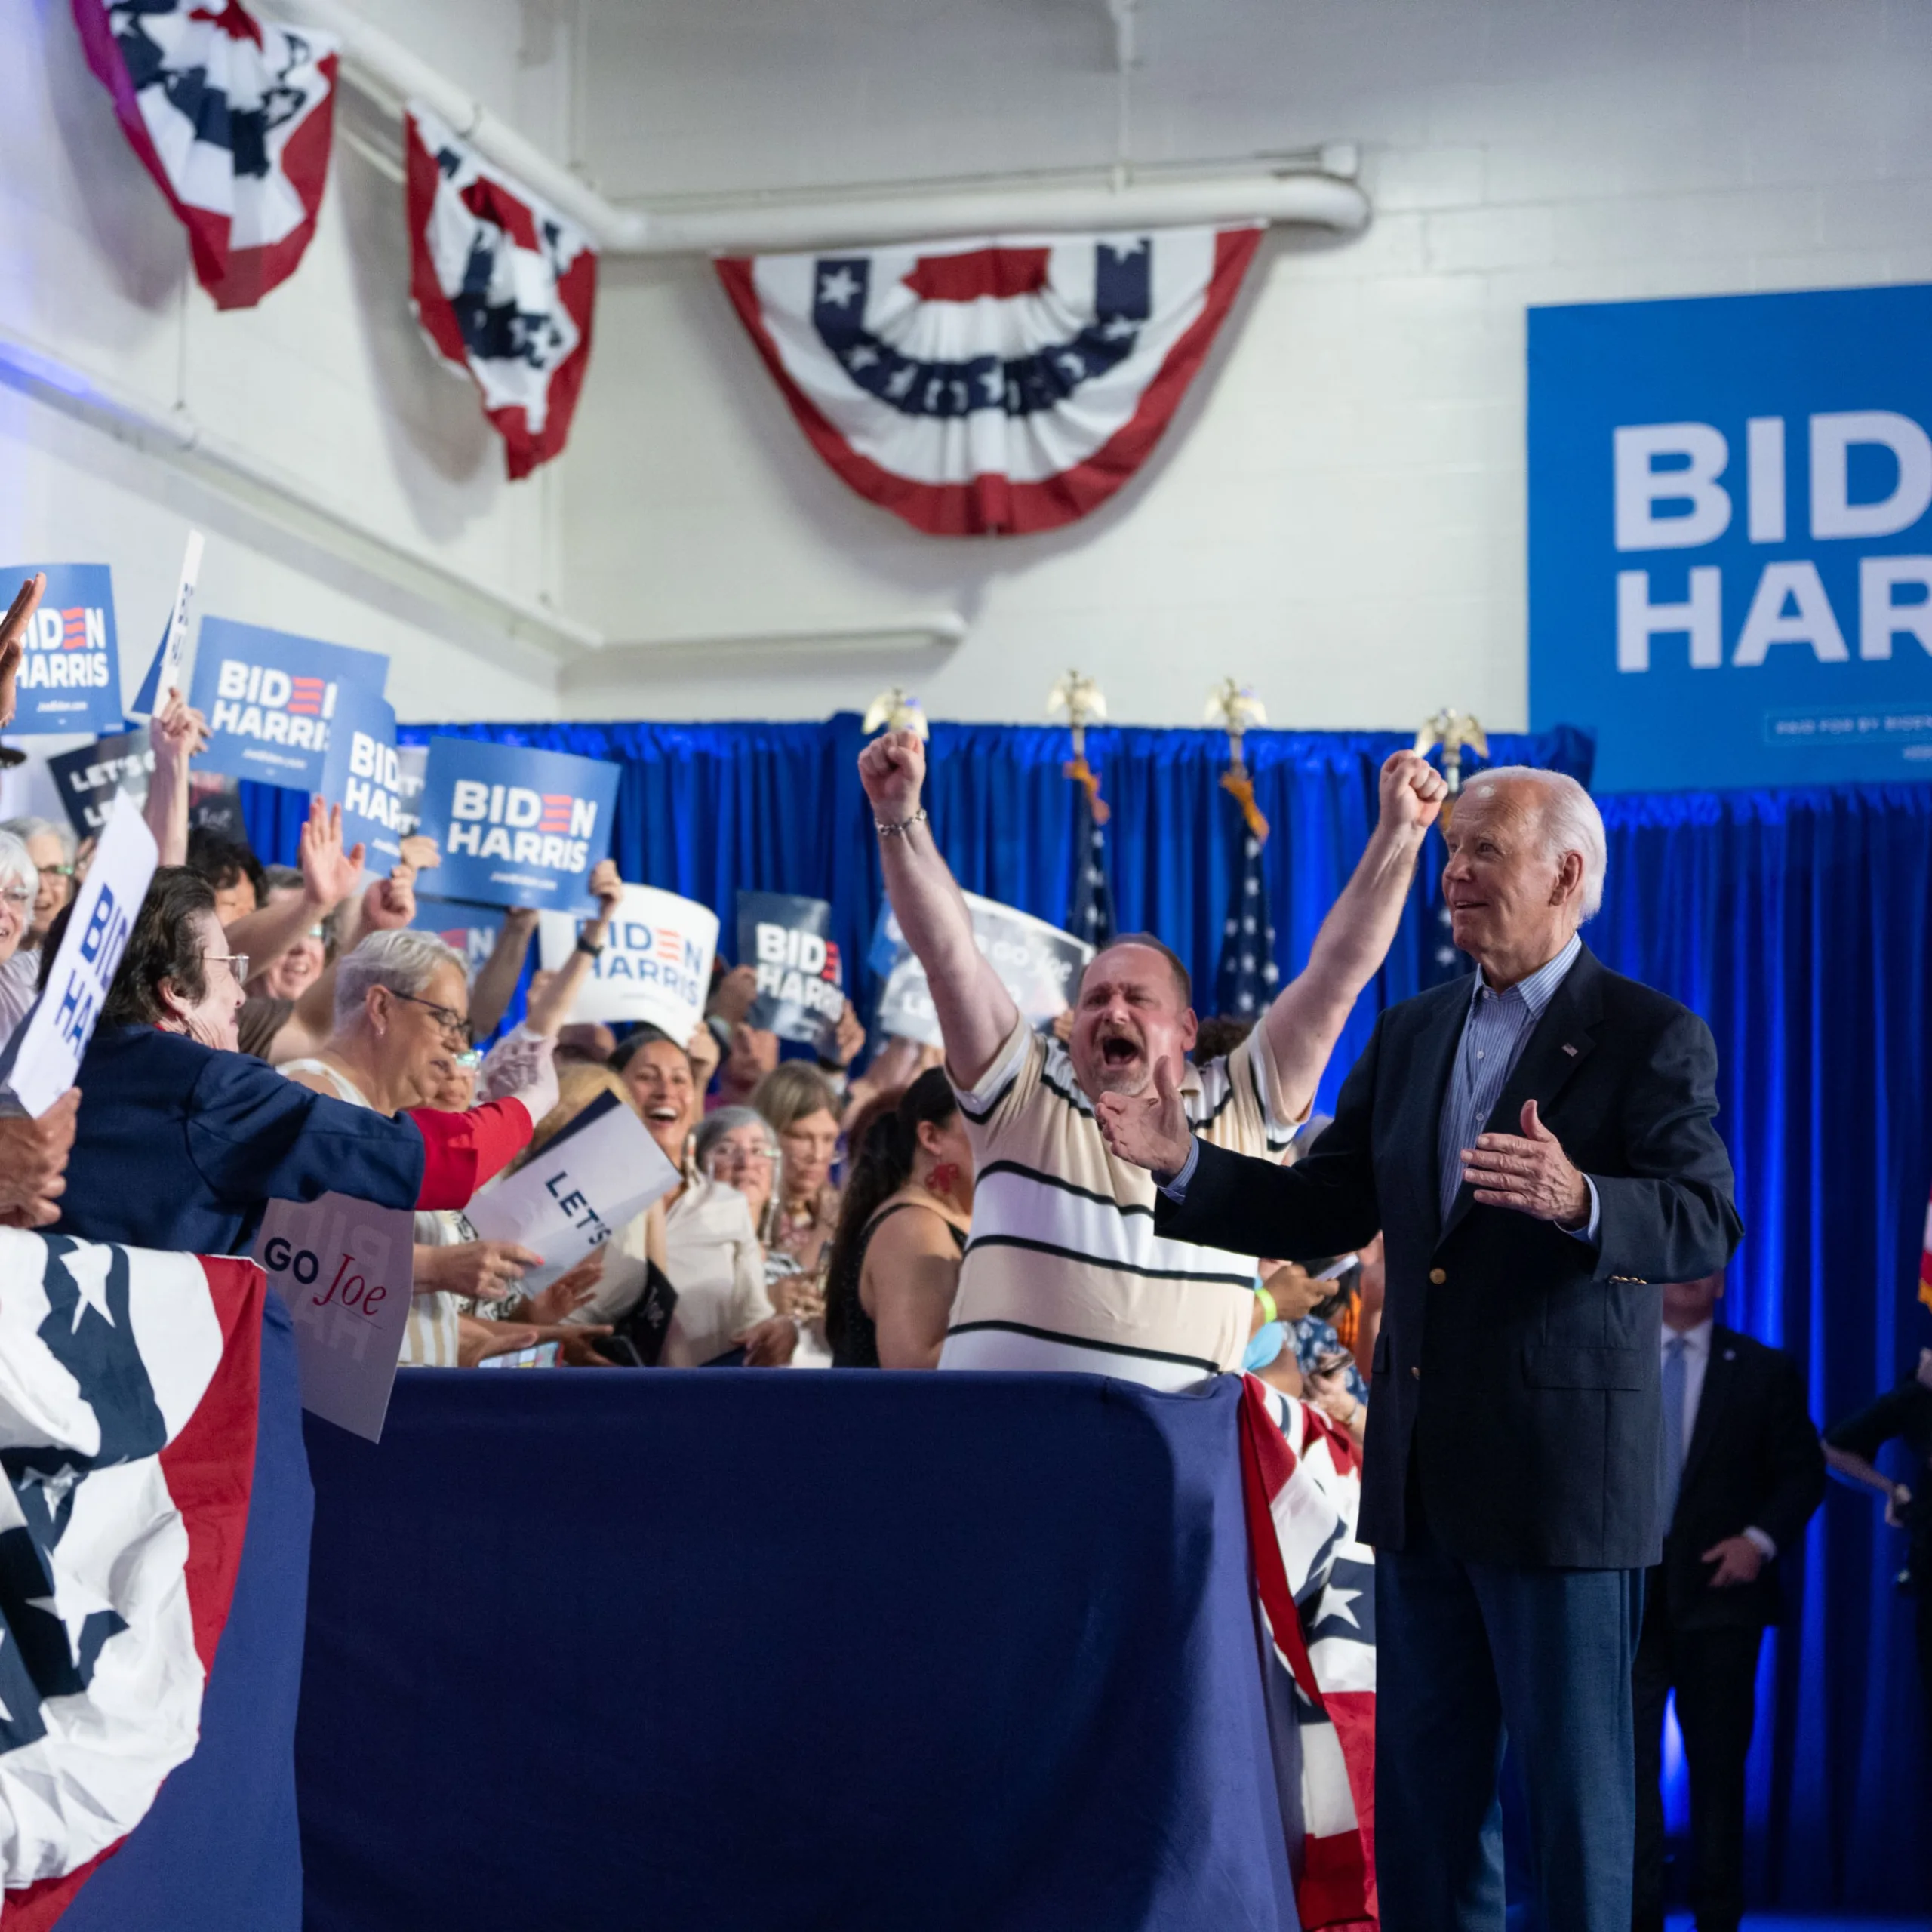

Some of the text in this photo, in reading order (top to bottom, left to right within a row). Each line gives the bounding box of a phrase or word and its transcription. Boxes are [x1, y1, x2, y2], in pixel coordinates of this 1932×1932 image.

[1612, 409, 1932, 552] BID
[211, 698, 331, 752] HARRI
[451, 780, 597, 839] BIDEN
[447, 821, 589, 873] HARRIS
[544, 1171, 612, 1246] LET'S
[264, 1237, 386, 1316] GO Joe
